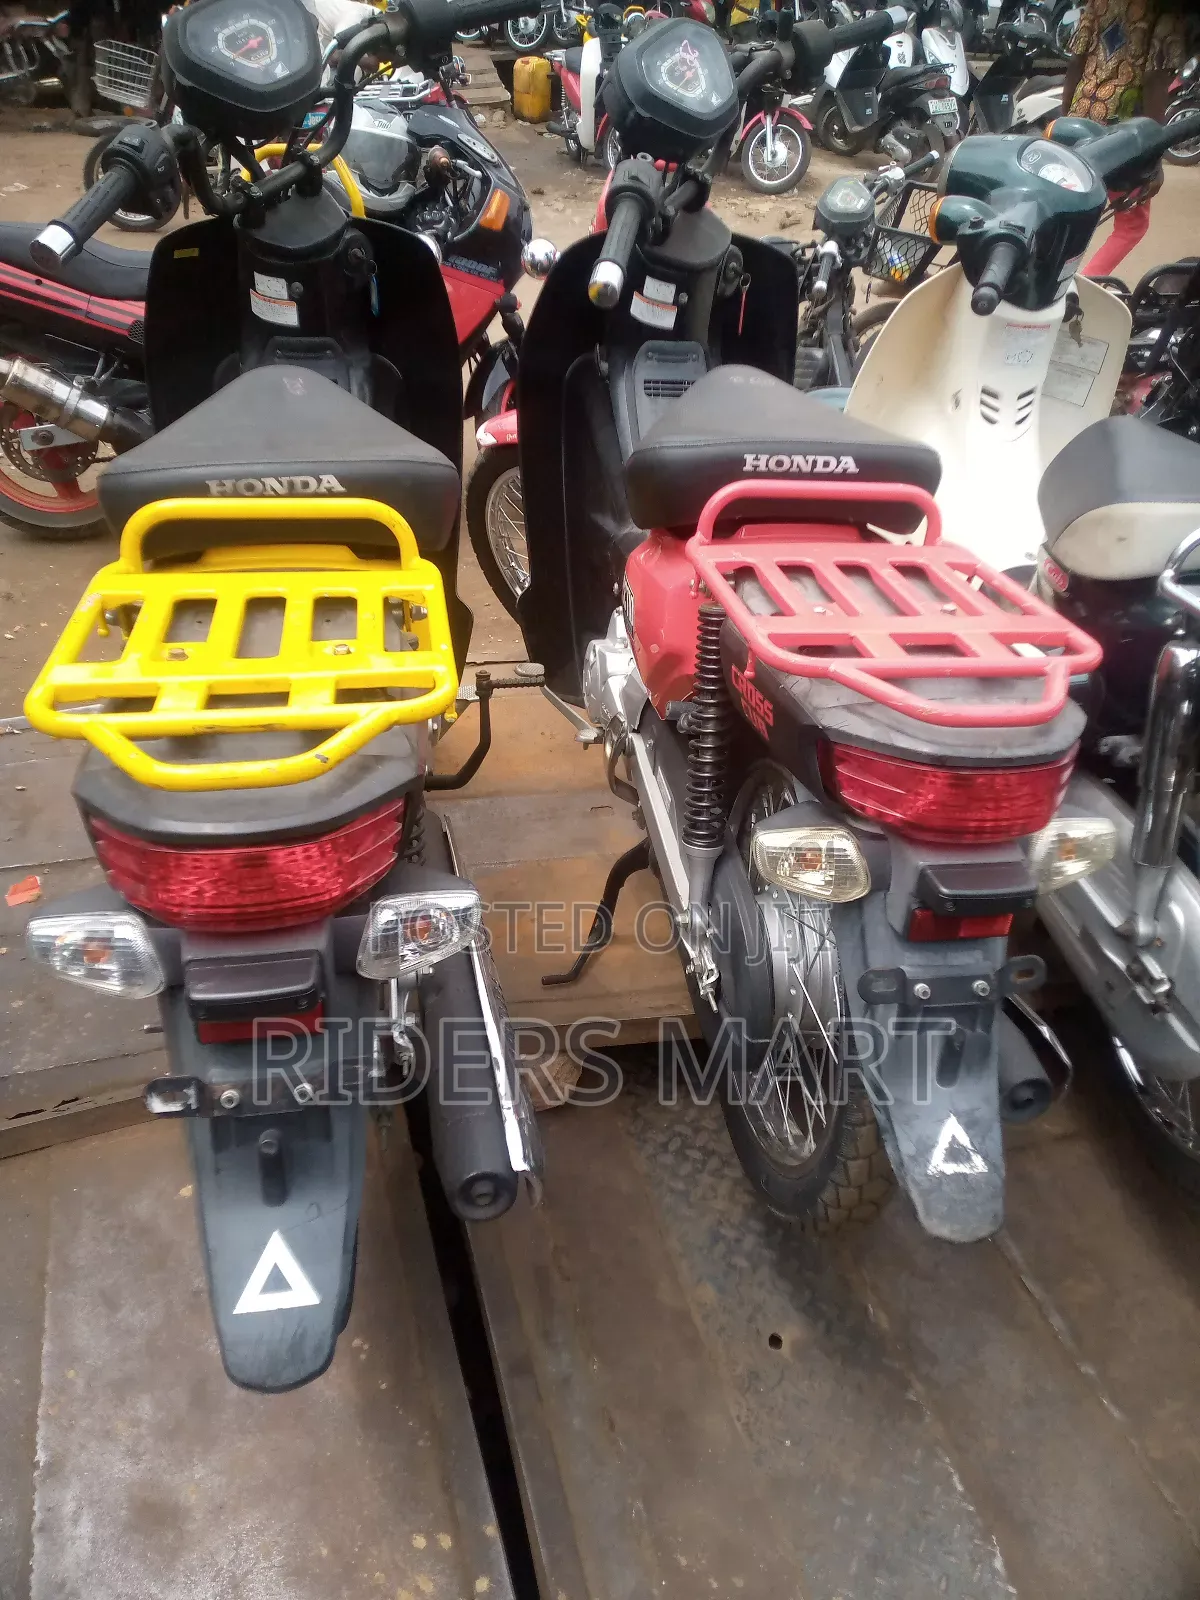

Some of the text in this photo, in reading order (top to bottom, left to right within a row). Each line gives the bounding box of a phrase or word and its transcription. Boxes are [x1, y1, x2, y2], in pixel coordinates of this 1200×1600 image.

[742, 453, 860, 474] HONDA
[205, 474, 347, 497] HONDA
[731, 664, 774, 727] CROSS
